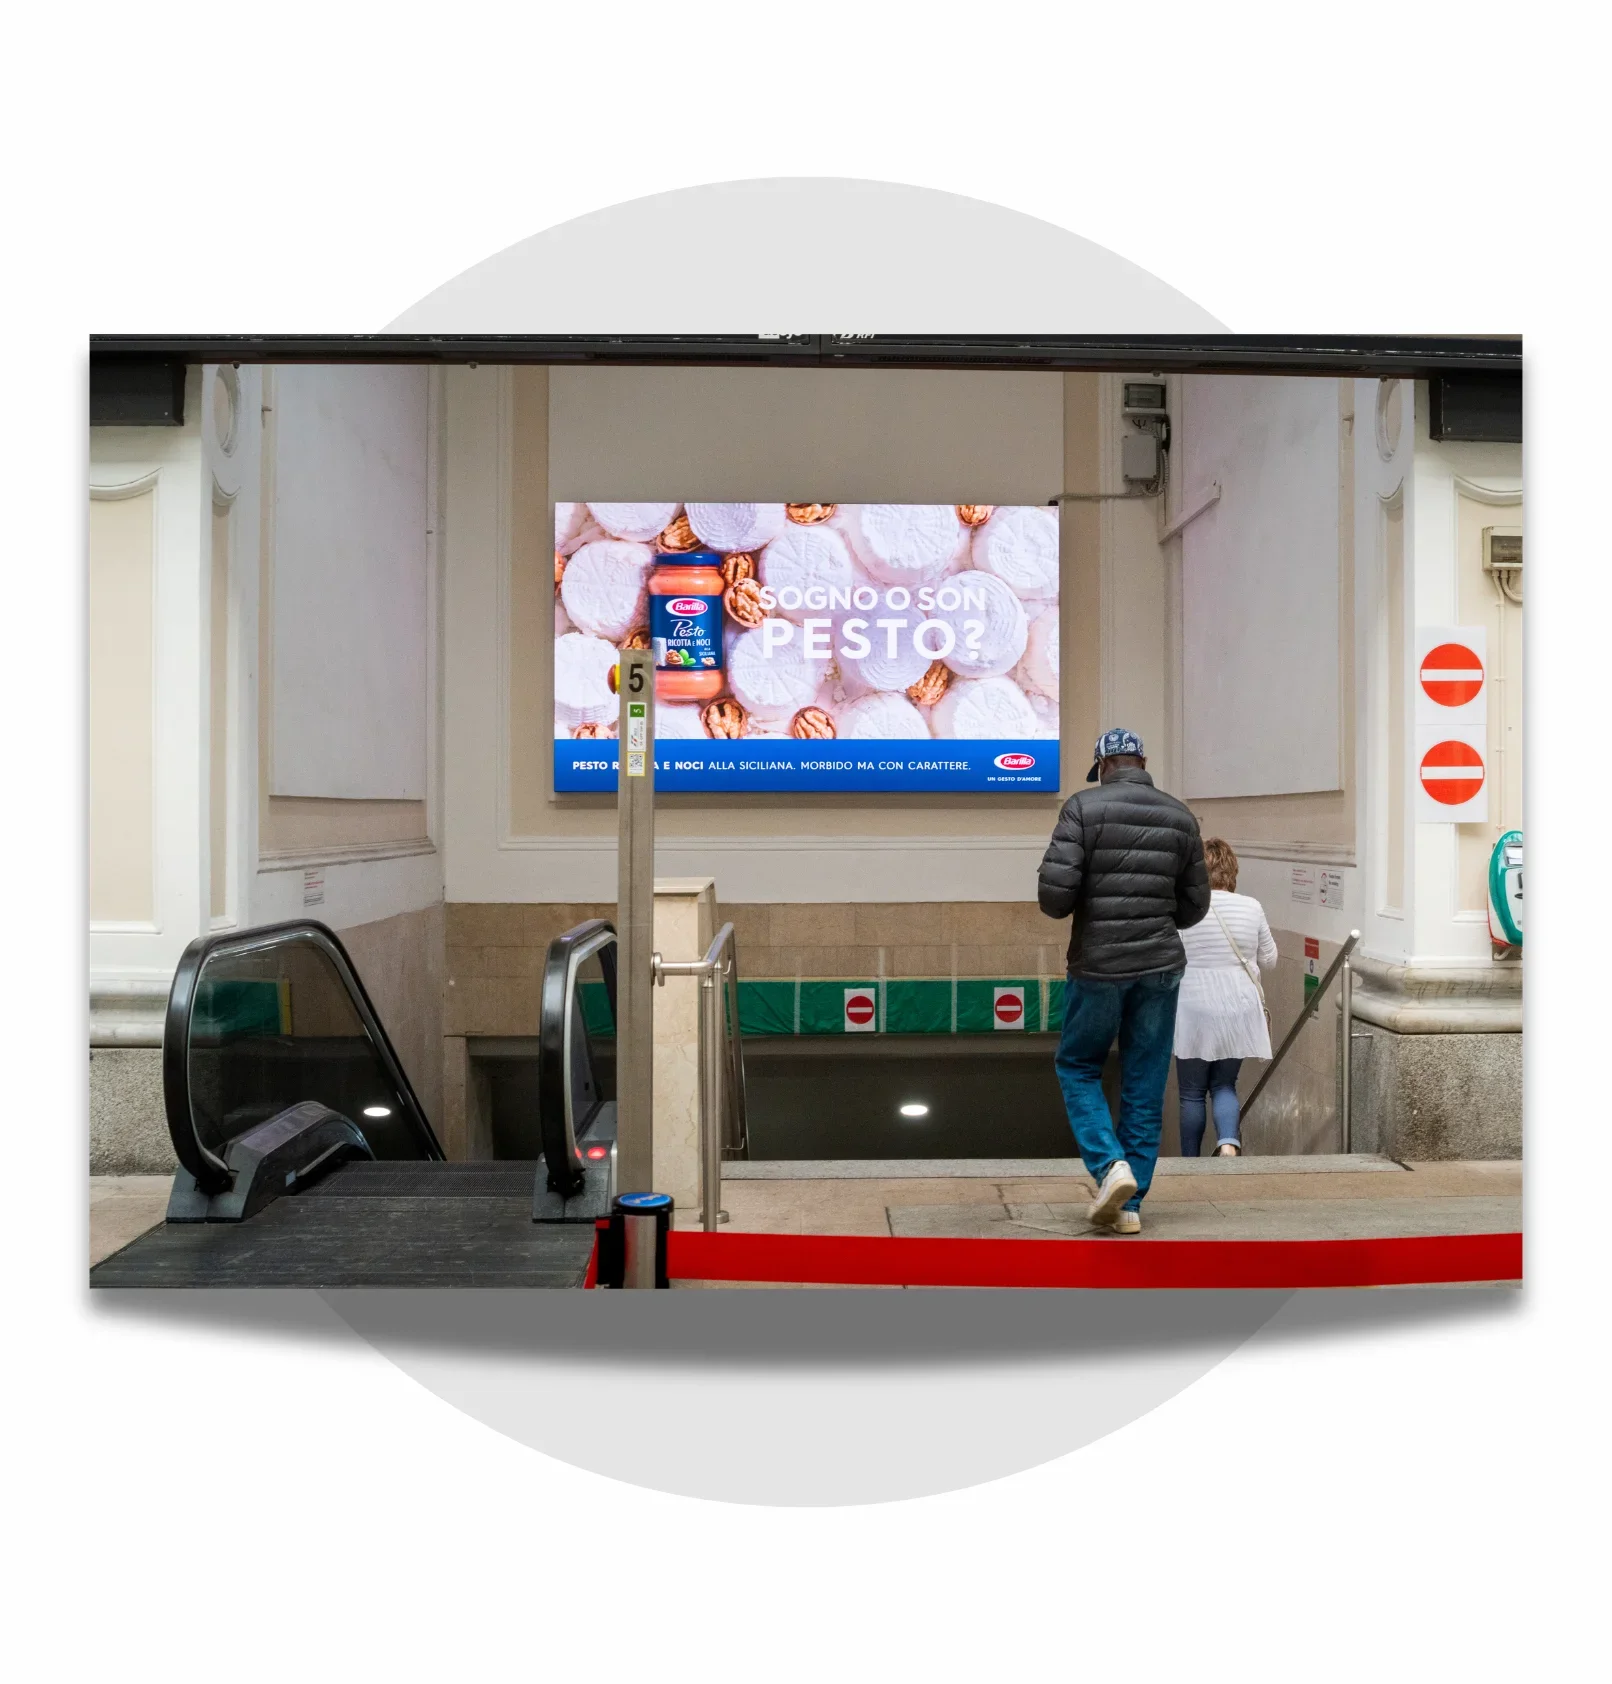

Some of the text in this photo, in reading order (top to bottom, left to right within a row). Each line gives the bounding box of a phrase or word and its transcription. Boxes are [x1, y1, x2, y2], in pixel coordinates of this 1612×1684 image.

[758, 586, 986, 612] SOGNO O SON
[675, 602, 705, 611] Barilla
[670, 618, 706, 637] Pesto
[667, 638, 692, 647] RICOTTA
[696, 638, 711, 646] NOCI
[762, 618, 986, 660] PESTO?
[628, 663, 644, 693] 5
[573, 761, 608, 770] PESTO
[663, 761, 670, 770] E
[675, 761, 704, 770] NOCI
[708, 761, 735, 770] ALLA
[739, 761, 796, 770] SICILIANA.
[800, 761, 852, 770] MORBIDO
[857, 761, 875, 770] MA
[878, 761, 904, 770] CON
[908, 761, 971, 770] CARATTERE.
[1003, 756, 1032, 766] Barilla
